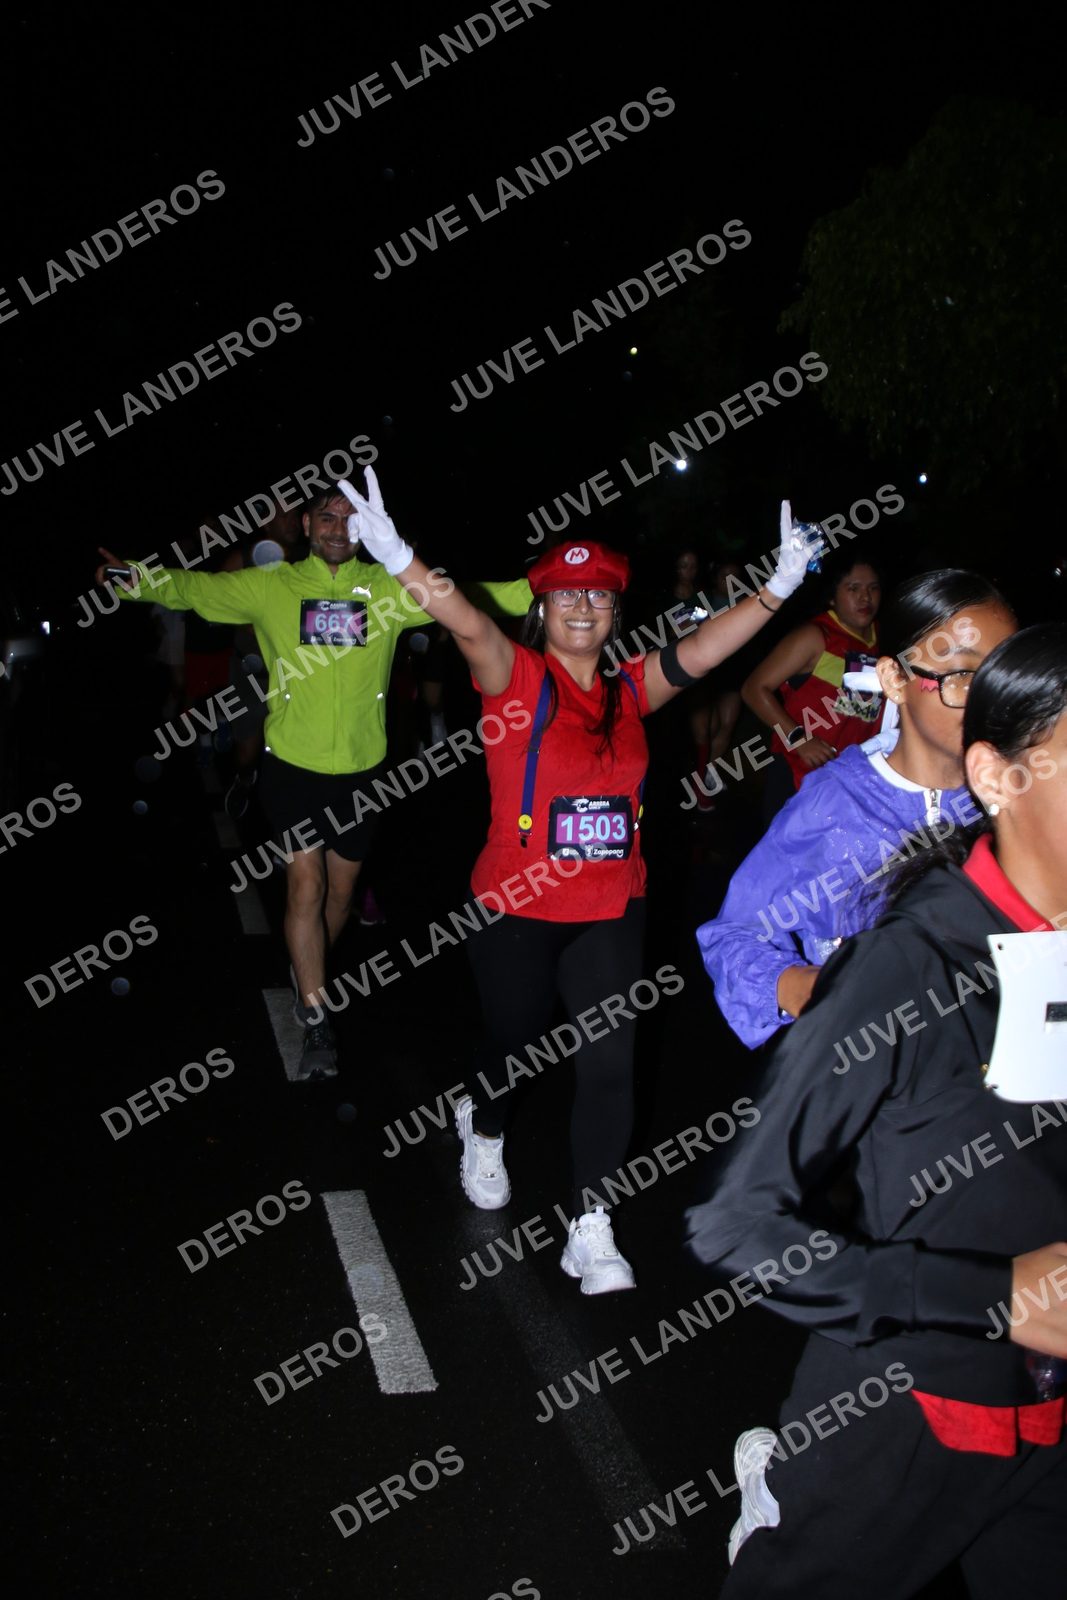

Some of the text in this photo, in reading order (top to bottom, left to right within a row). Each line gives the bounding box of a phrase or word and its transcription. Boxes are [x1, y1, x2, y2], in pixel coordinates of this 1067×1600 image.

[569, 548, 586, 562] M
[315, 613, 354, 633] 667
[561, 814, 626, 841] 1503
